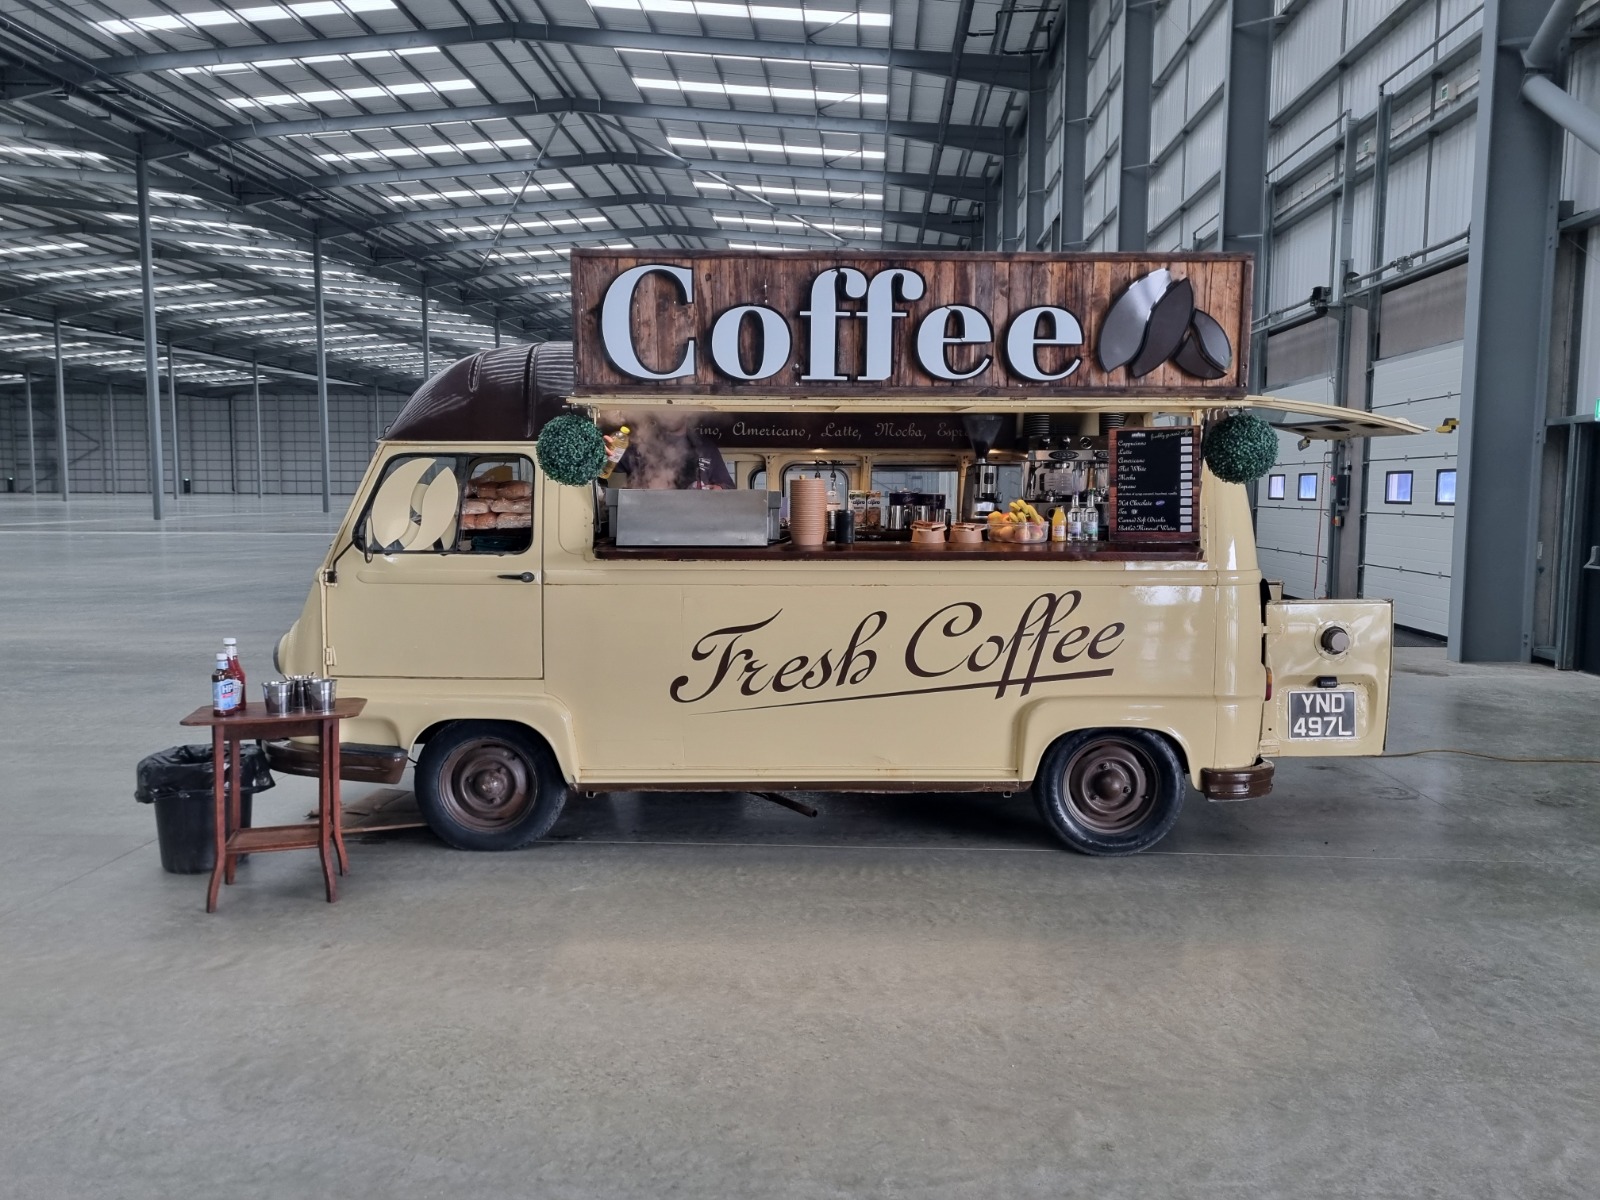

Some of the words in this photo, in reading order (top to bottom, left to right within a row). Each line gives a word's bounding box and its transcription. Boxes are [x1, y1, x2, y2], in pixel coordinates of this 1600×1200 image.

[601, 264, 1084, 381] Coffee
[732, 421, 811, 440] Americano,
[820, 422, 862, 440] Latte,
[874, 422, 927, 440] Mocha,
[669, 607, 888, 704] Fresh
[904, 589, 1126, 700] Coffee
[221, 682, 234, 694] HP
[1301, 693, 1346, 714] YND
[1293, 716, 1353, 737] 497L
